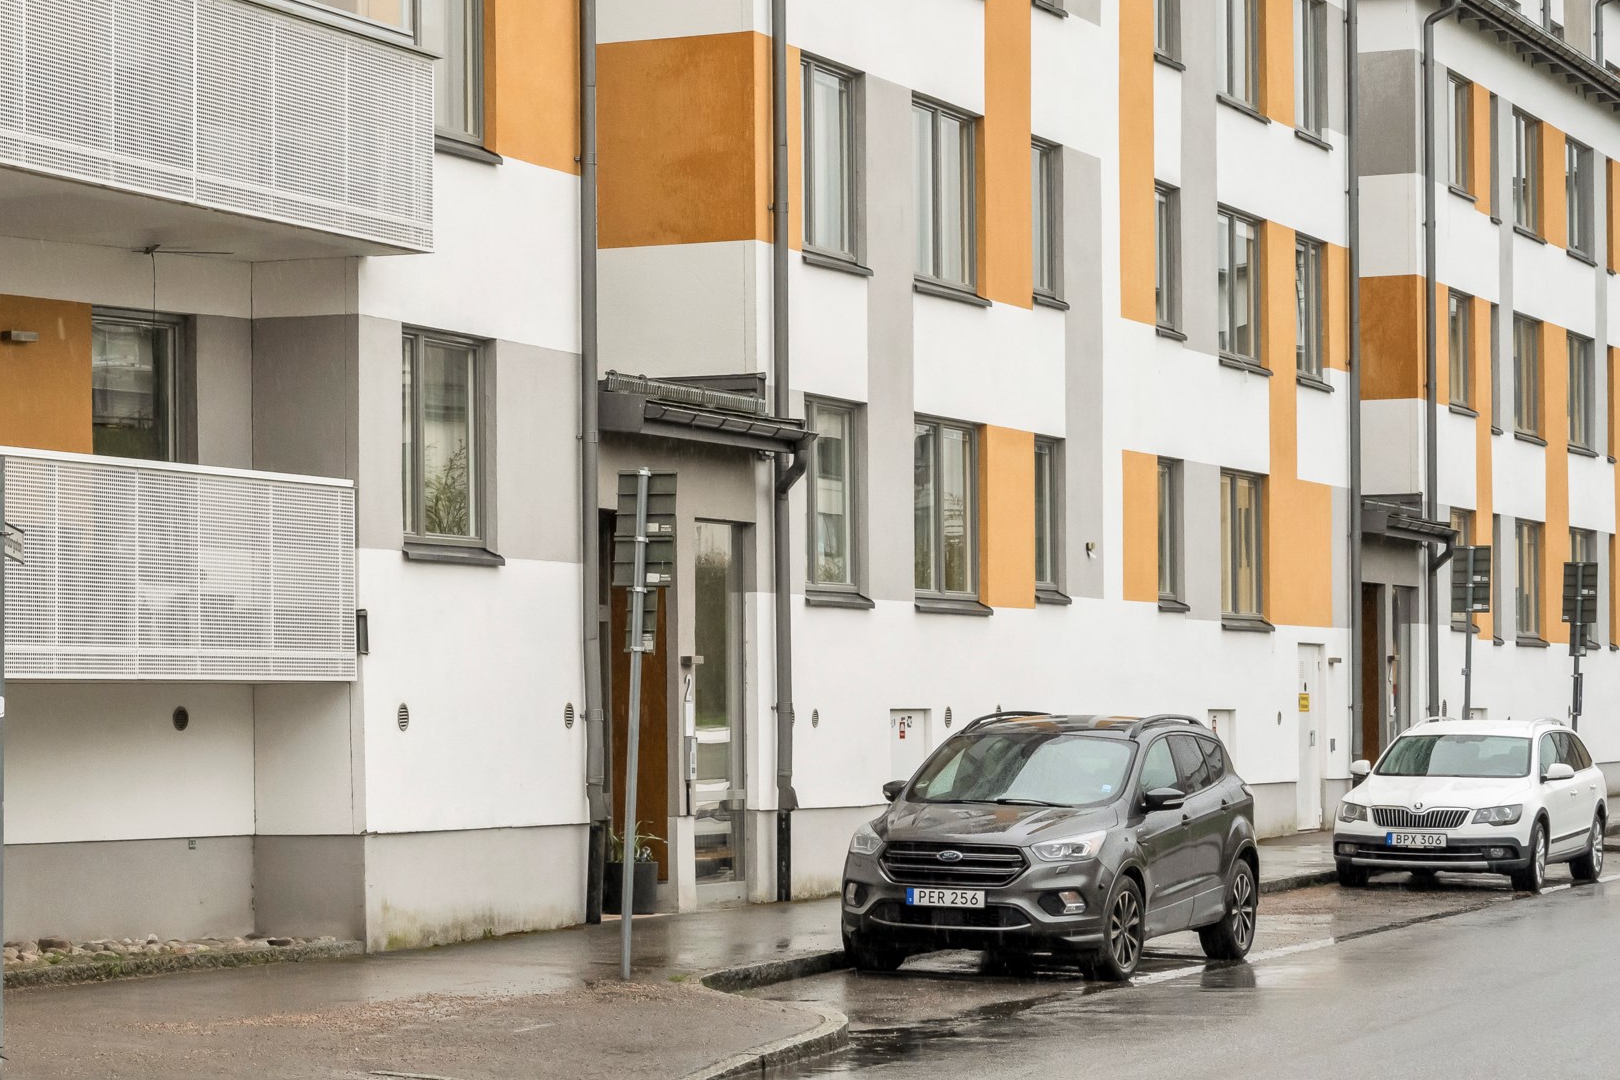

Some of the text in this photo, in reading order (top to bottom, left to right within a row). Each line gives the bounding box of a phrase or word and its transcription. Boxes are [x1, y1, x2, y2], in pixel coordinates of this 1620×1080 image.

[684, 674, 692, 702] 2
[1396, 834, 1442, 845] BPX 306
[918, 890, 979, 906] PER 256
